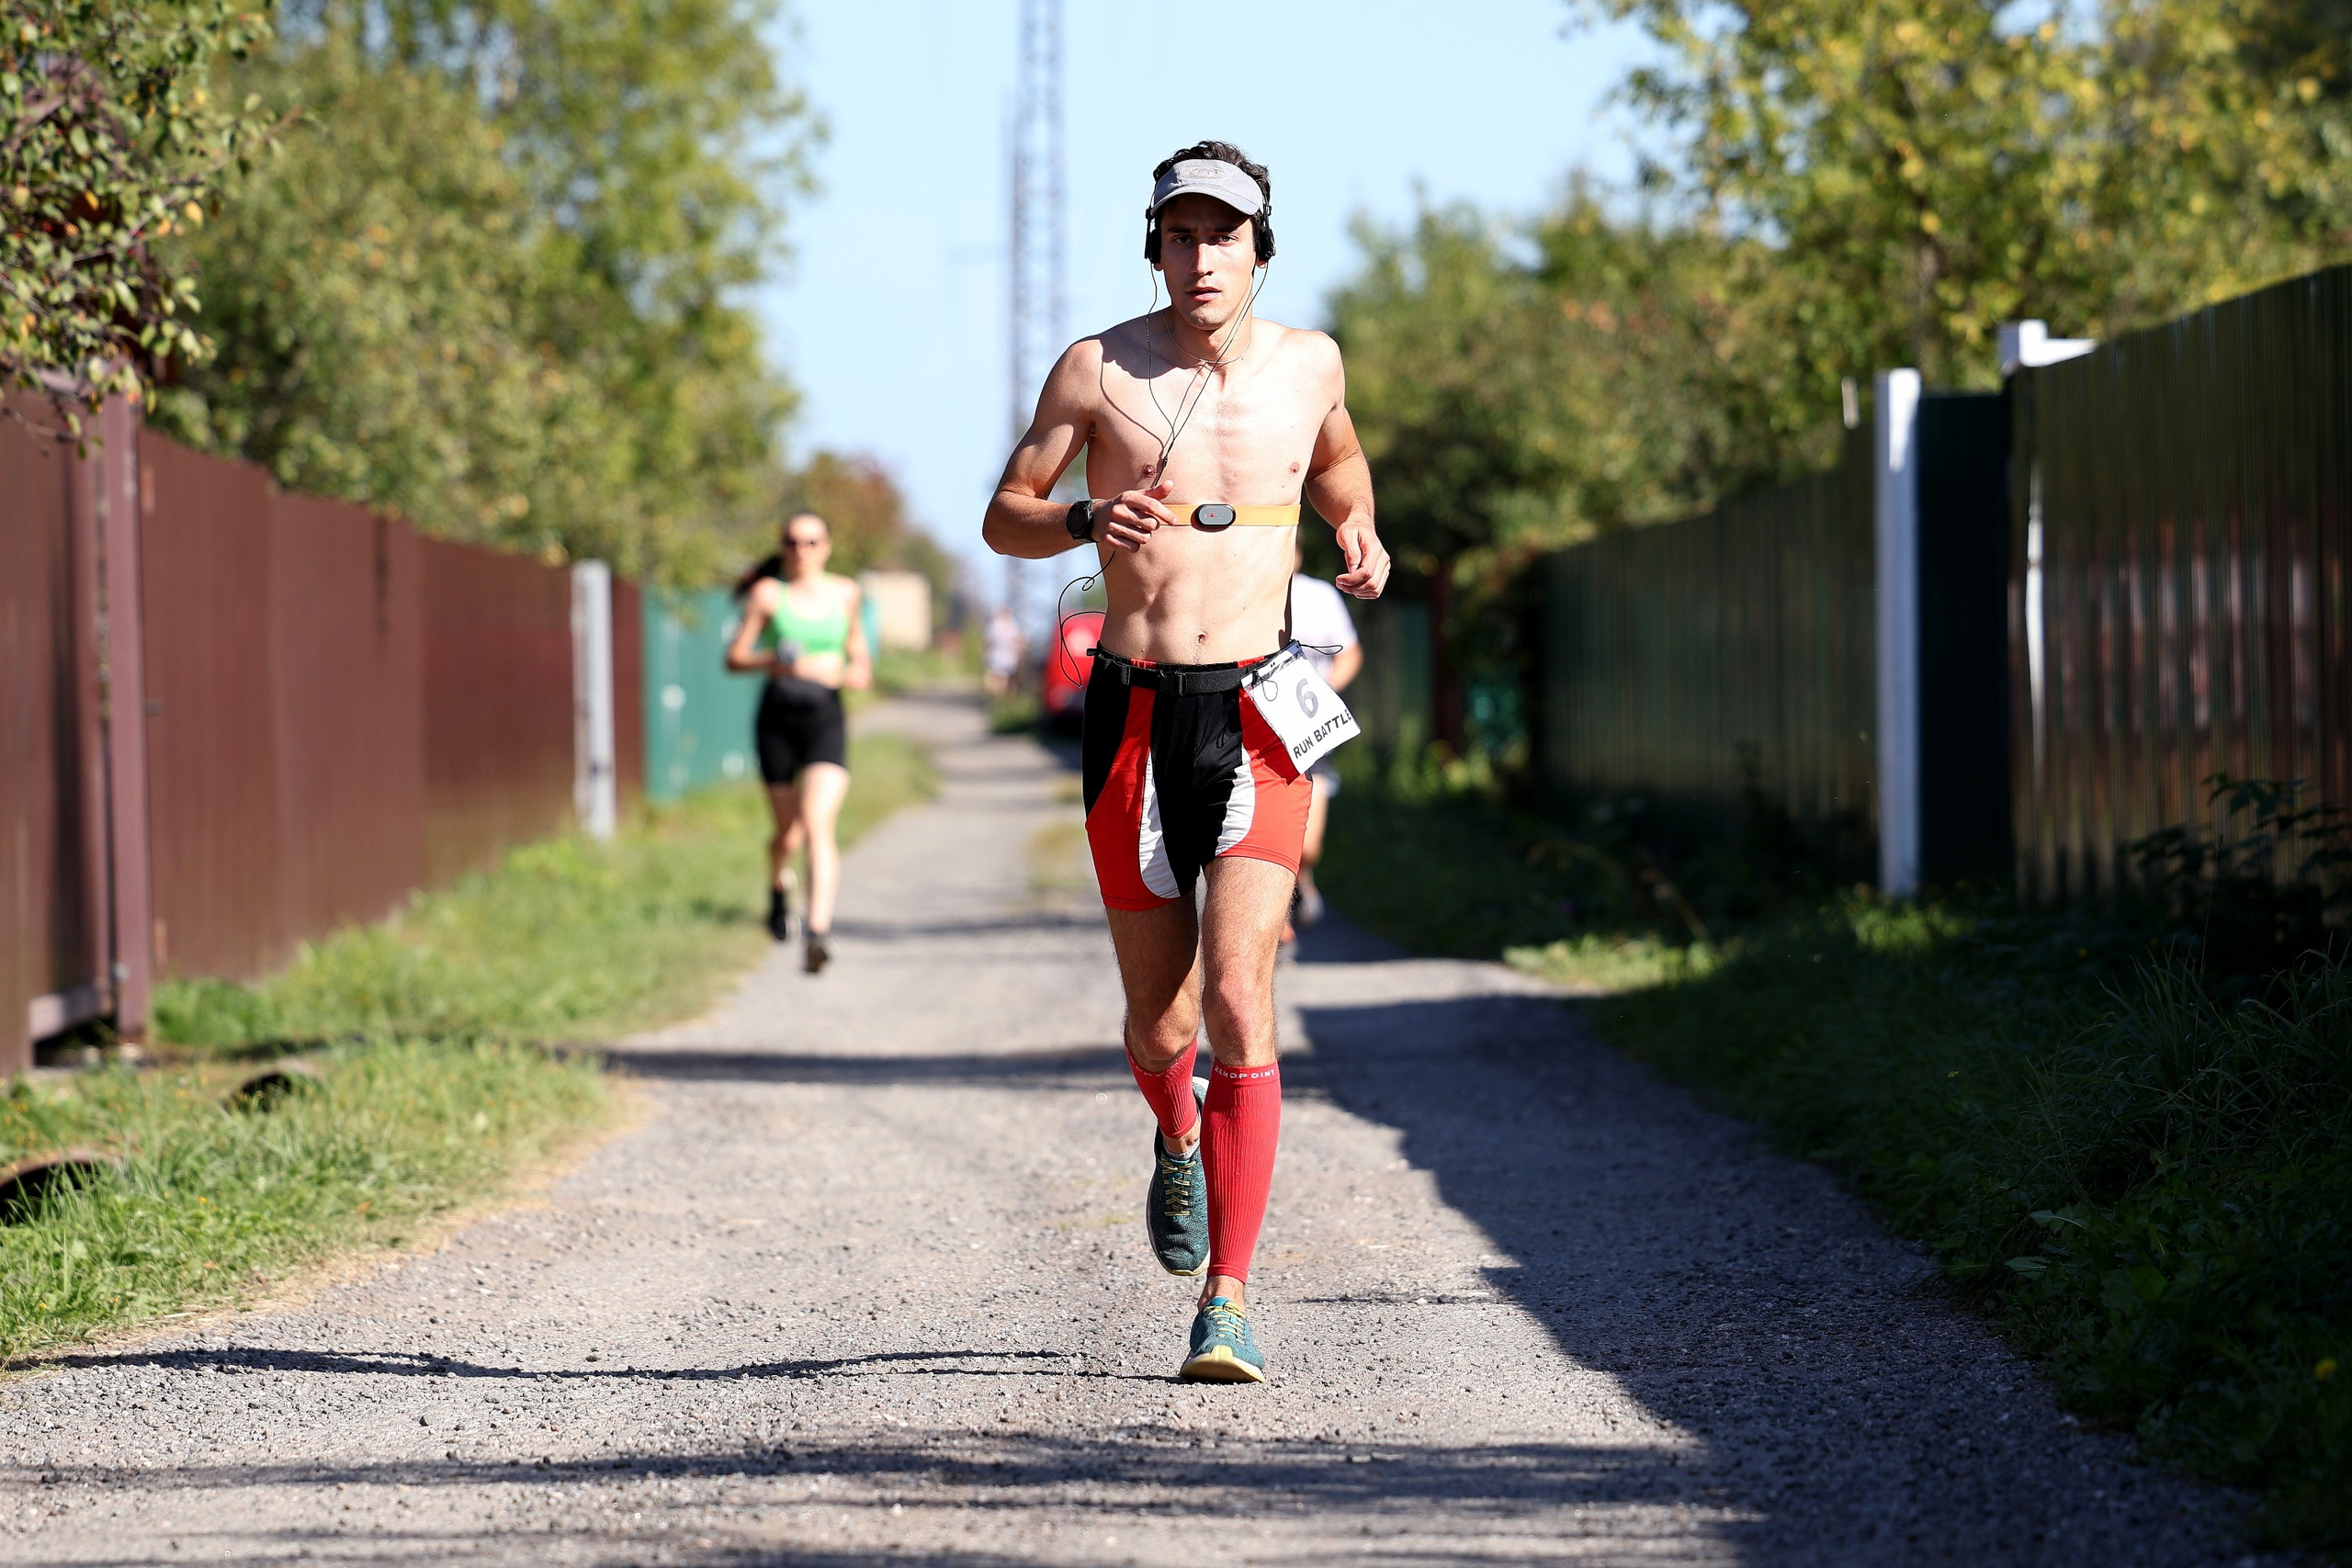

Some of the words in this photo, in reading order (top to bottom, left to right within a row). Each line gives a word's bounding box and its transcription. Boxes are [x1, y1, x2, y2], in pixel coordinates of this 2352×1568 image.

[1296, 678, 1318, 718] 6
[1293, 736, 1314, 759] RUN
[1313, 709, 1352, 743] BATTLE
